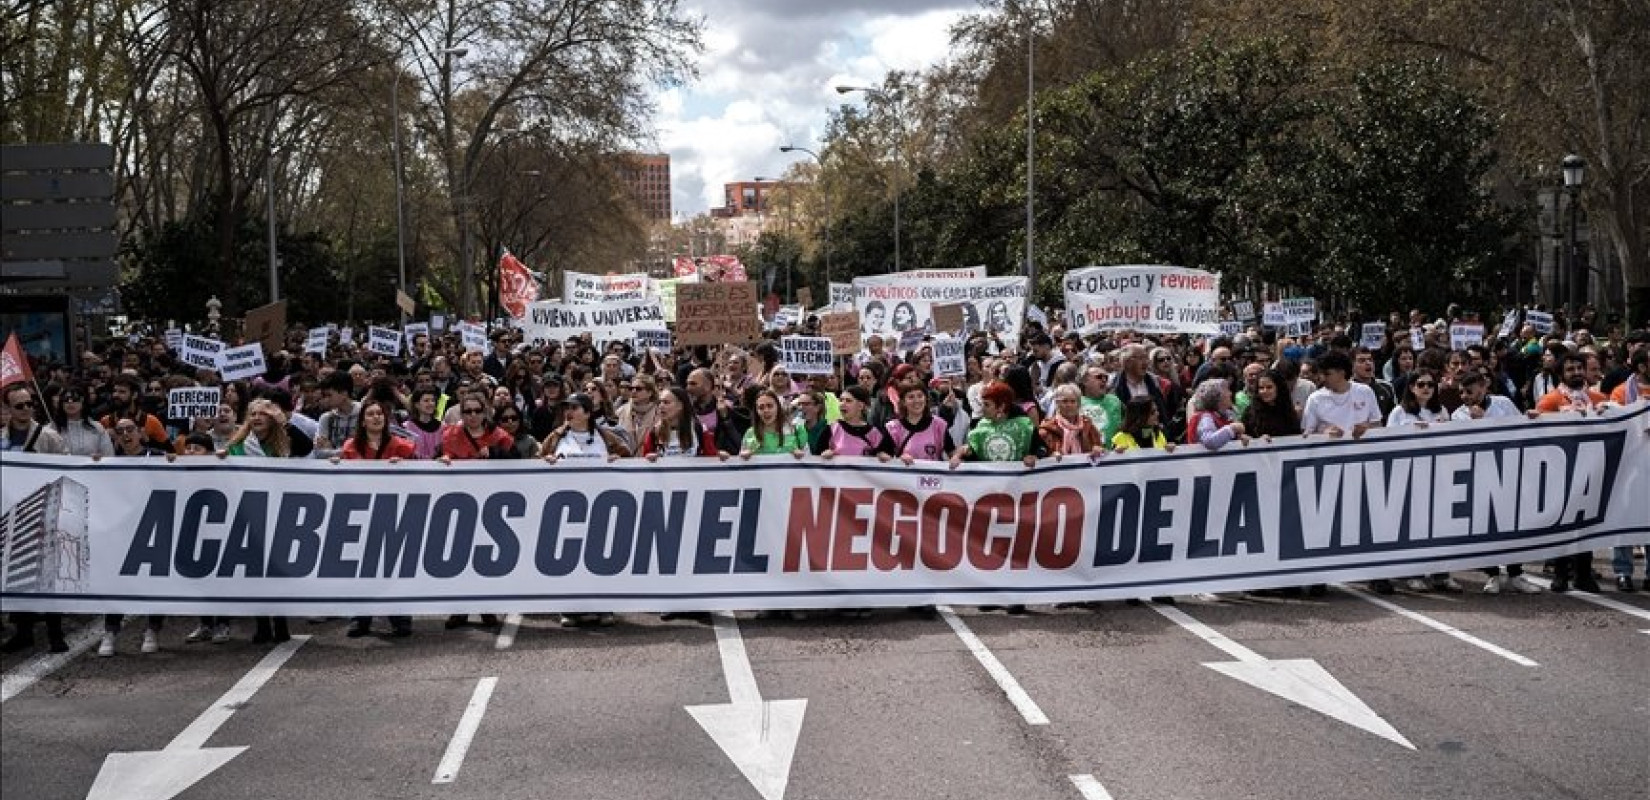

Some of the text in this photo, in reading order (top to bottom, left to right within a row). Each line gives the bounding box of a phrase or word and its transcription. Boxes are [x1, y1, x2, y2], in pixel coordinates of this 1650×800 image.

[868, 283, 918, 299] POLÍTICOS
[970, 286, 982, 299] DE
[1087, 274, 1140, 293] Okupa
[1146, 274, 1155, 292] y
[532, 305, 663, 328] VIVIENDA UNIVERSAL
[1086, 299, 1151, 322] burbuja
[1155, 299, 1175, 321] de
[784, 339, 831, 351] DERECHO
[786, 352, 832, 363] A TECHO
[171, 391, 219, 404] DERECHO
[169, 405, 177, 417] A
[119, 442, 1605, 578] ACABEMOS CON EL NEGOCIO DE LA VIVIENDA
